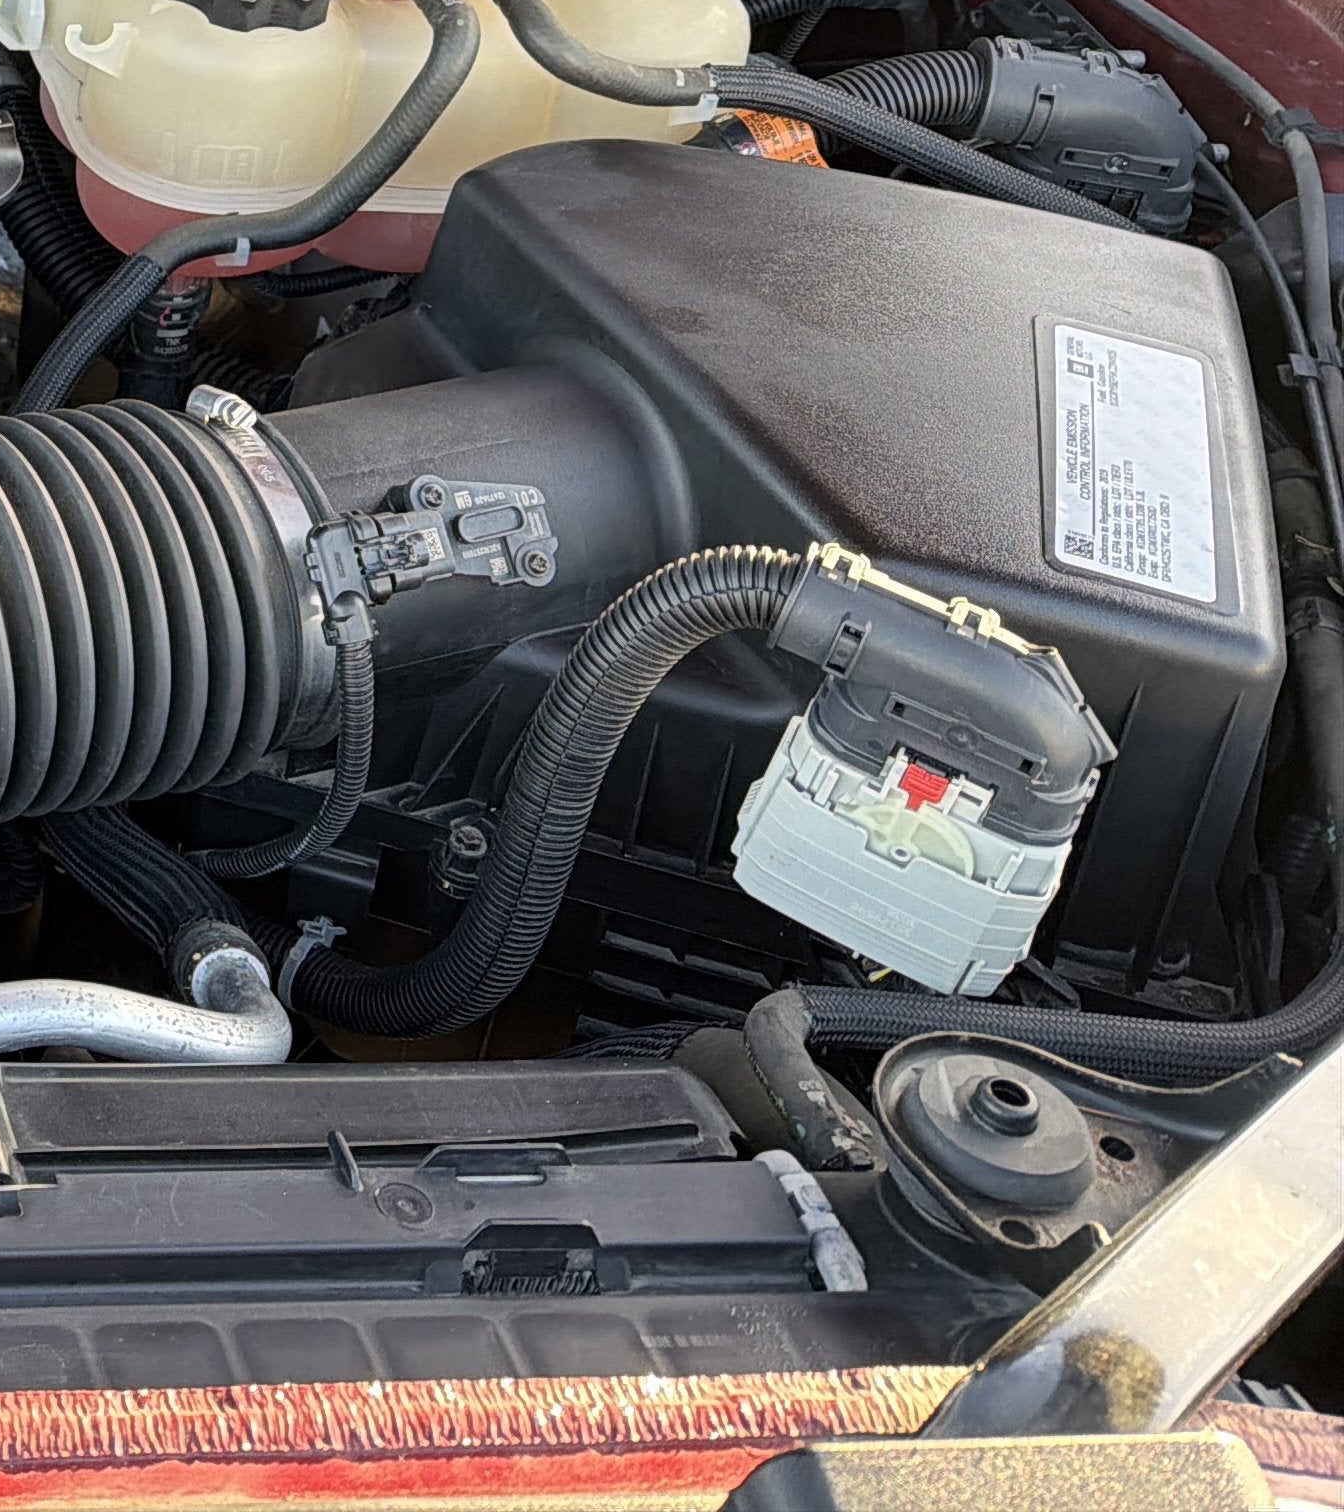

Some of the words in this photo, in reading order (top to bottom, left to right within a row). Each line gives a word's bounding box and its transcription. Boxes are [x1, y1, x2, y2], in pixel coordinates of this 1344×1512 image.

[1066, 409, 1077, 448] EMISSION
[1079, 403, 1091, 458] INFORMATION
[1066, 448, 1077, 484] VEHICLE
[1080, 461, 1091, 500] CONTROL
[454, 491, 473, 510] GM
[1099, 534, 1109, 565] Conforms
[1112, 541, 1122, 555] EPA
[1124, 541, 1134, 572] California
